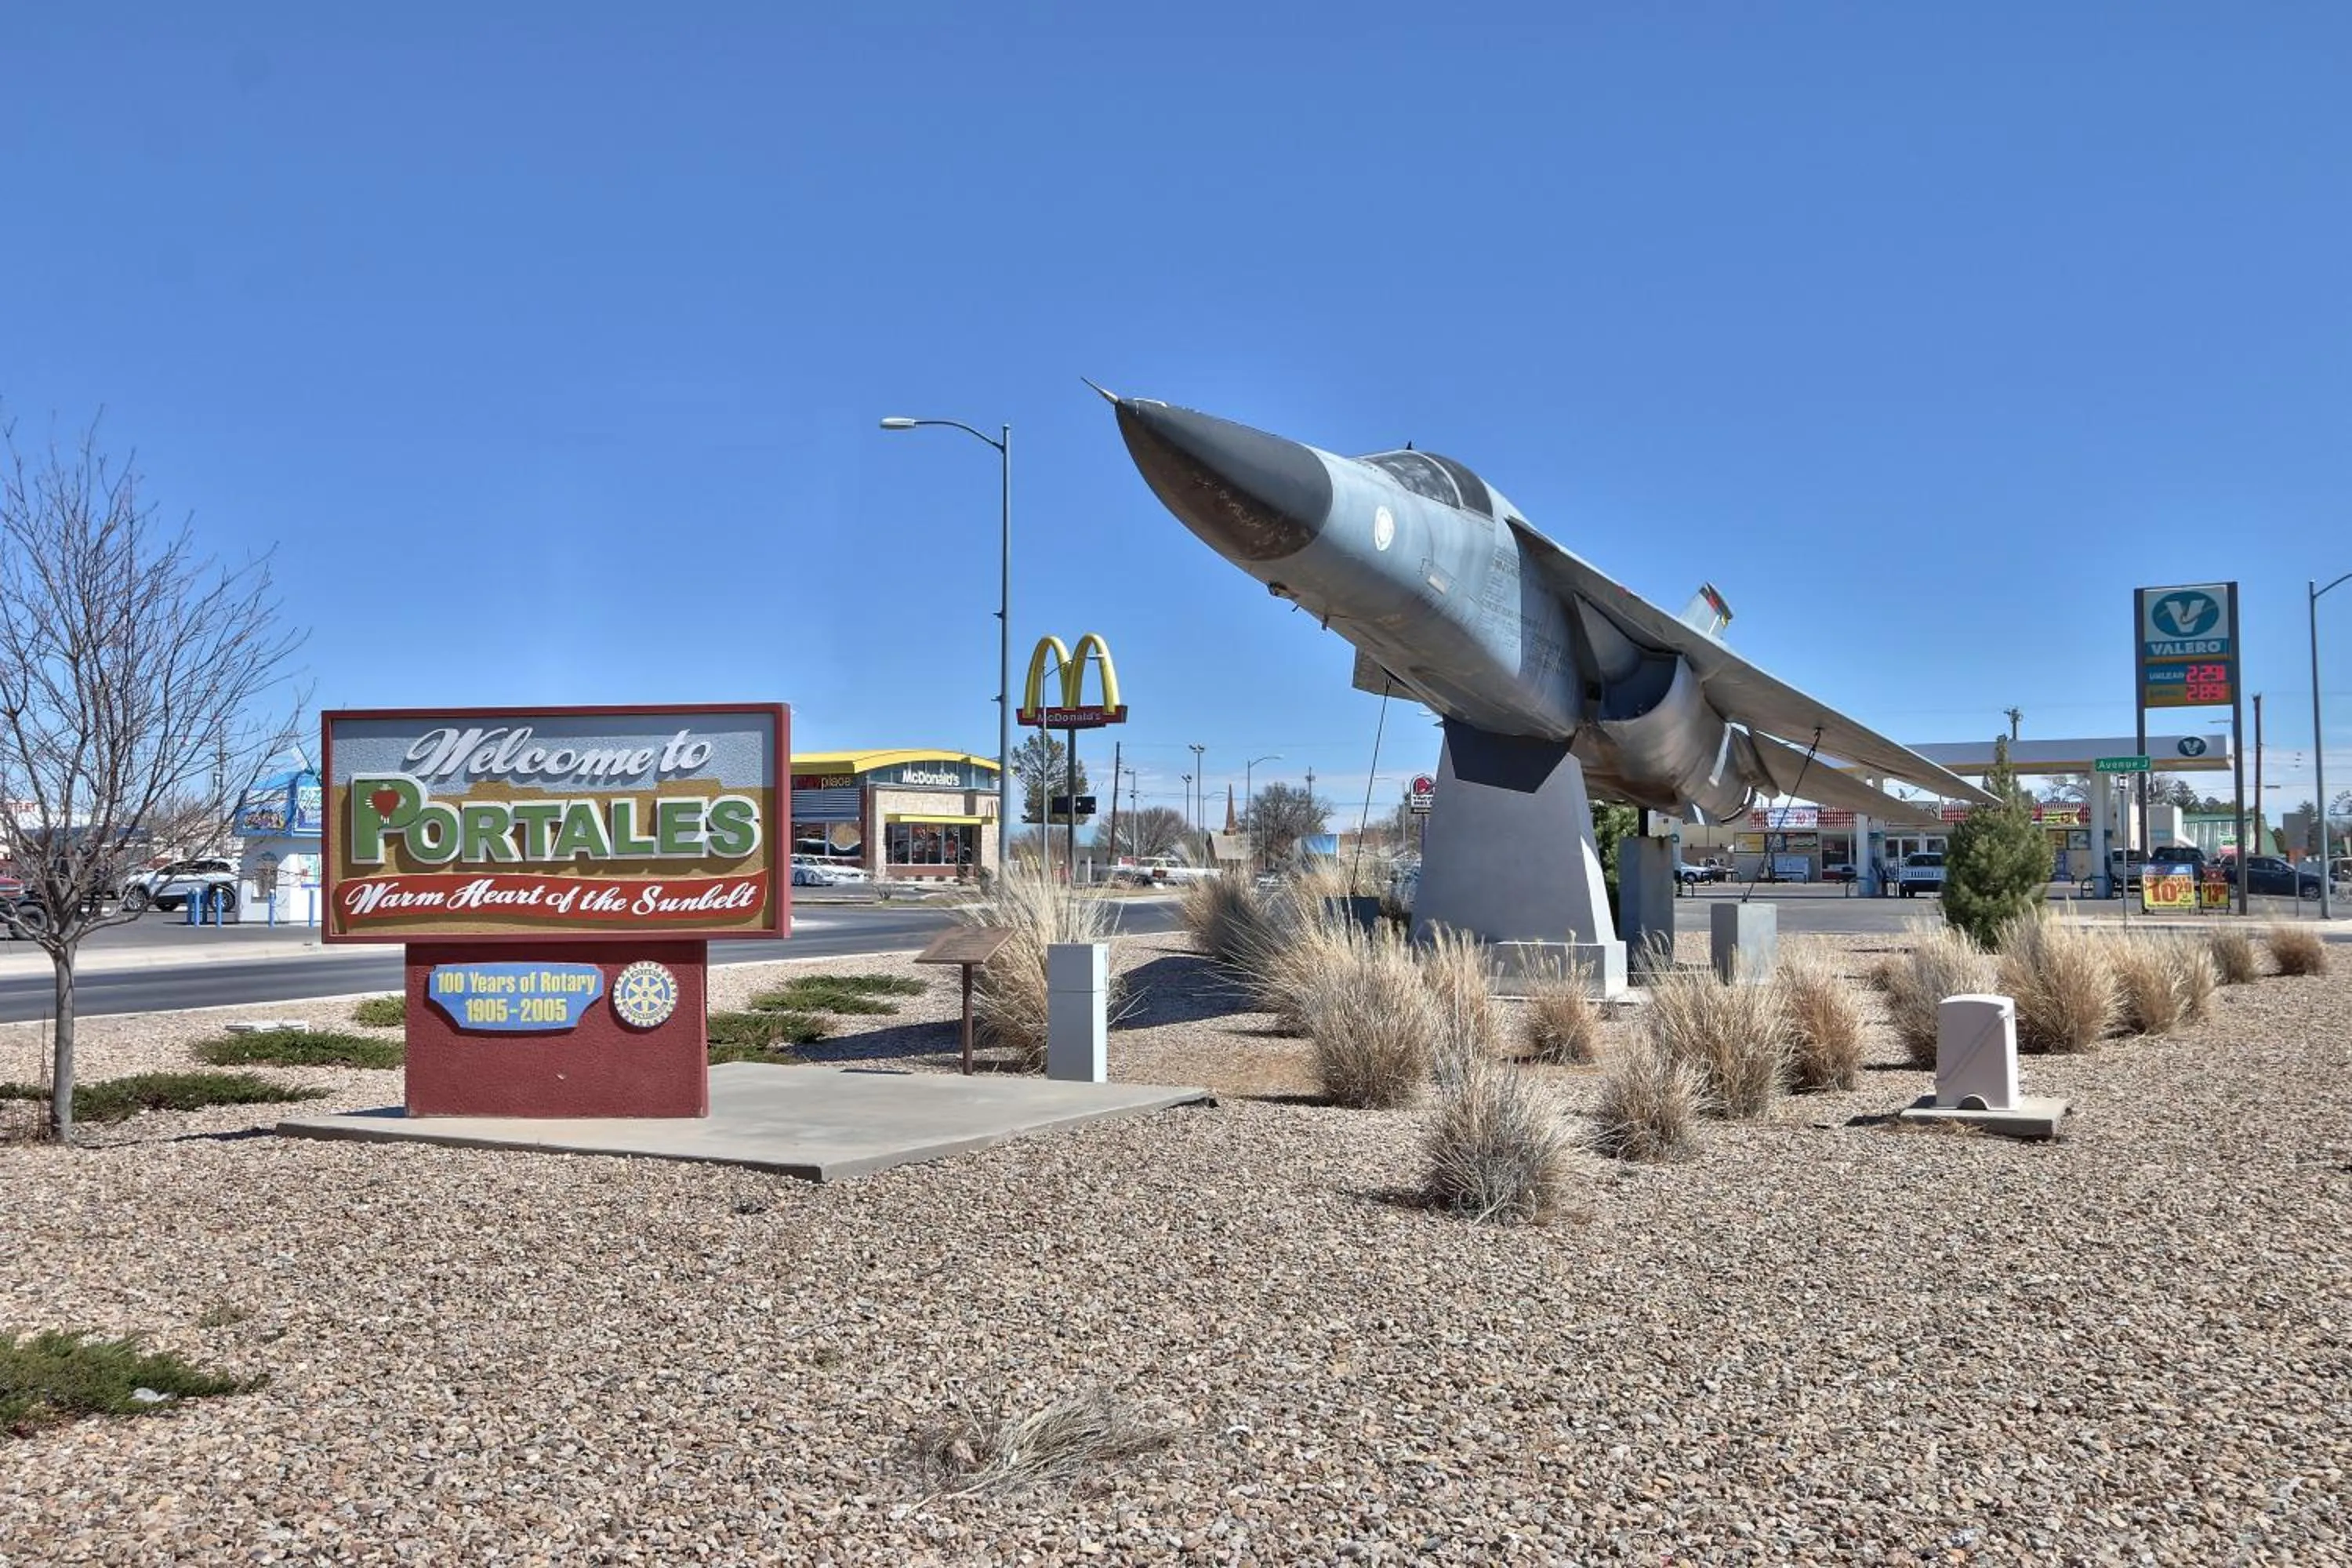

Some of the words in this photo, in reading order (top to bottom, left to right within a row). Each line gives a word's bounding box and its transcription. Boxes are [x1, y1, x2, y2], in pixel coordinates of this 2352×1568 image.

[2151, 641, 2220, 655] VALERO
[1037, 711, 1102, 723] McDonald's
[406, 728, 653, 777] Welcome
[659, 728, 713, 773] to
[902, 769, 960, 786] McDonald's
[351, 772, 761, 864] PORTALES
[345, 882, 444, 915] Warm
[446, 879, 546, 910] Heart
[546, 885, 583, 913] of
[579, 886, 627, 911] the
[631, 881, 758, 915] Sunbelt
[437, 972, 465, 993] 100
[469, 971, 515, 993] Years
[520, 972, 537, 993] of
[540, 972, 596, 995] Rotary
[465, 999, 567, 1022] 1905-2005
